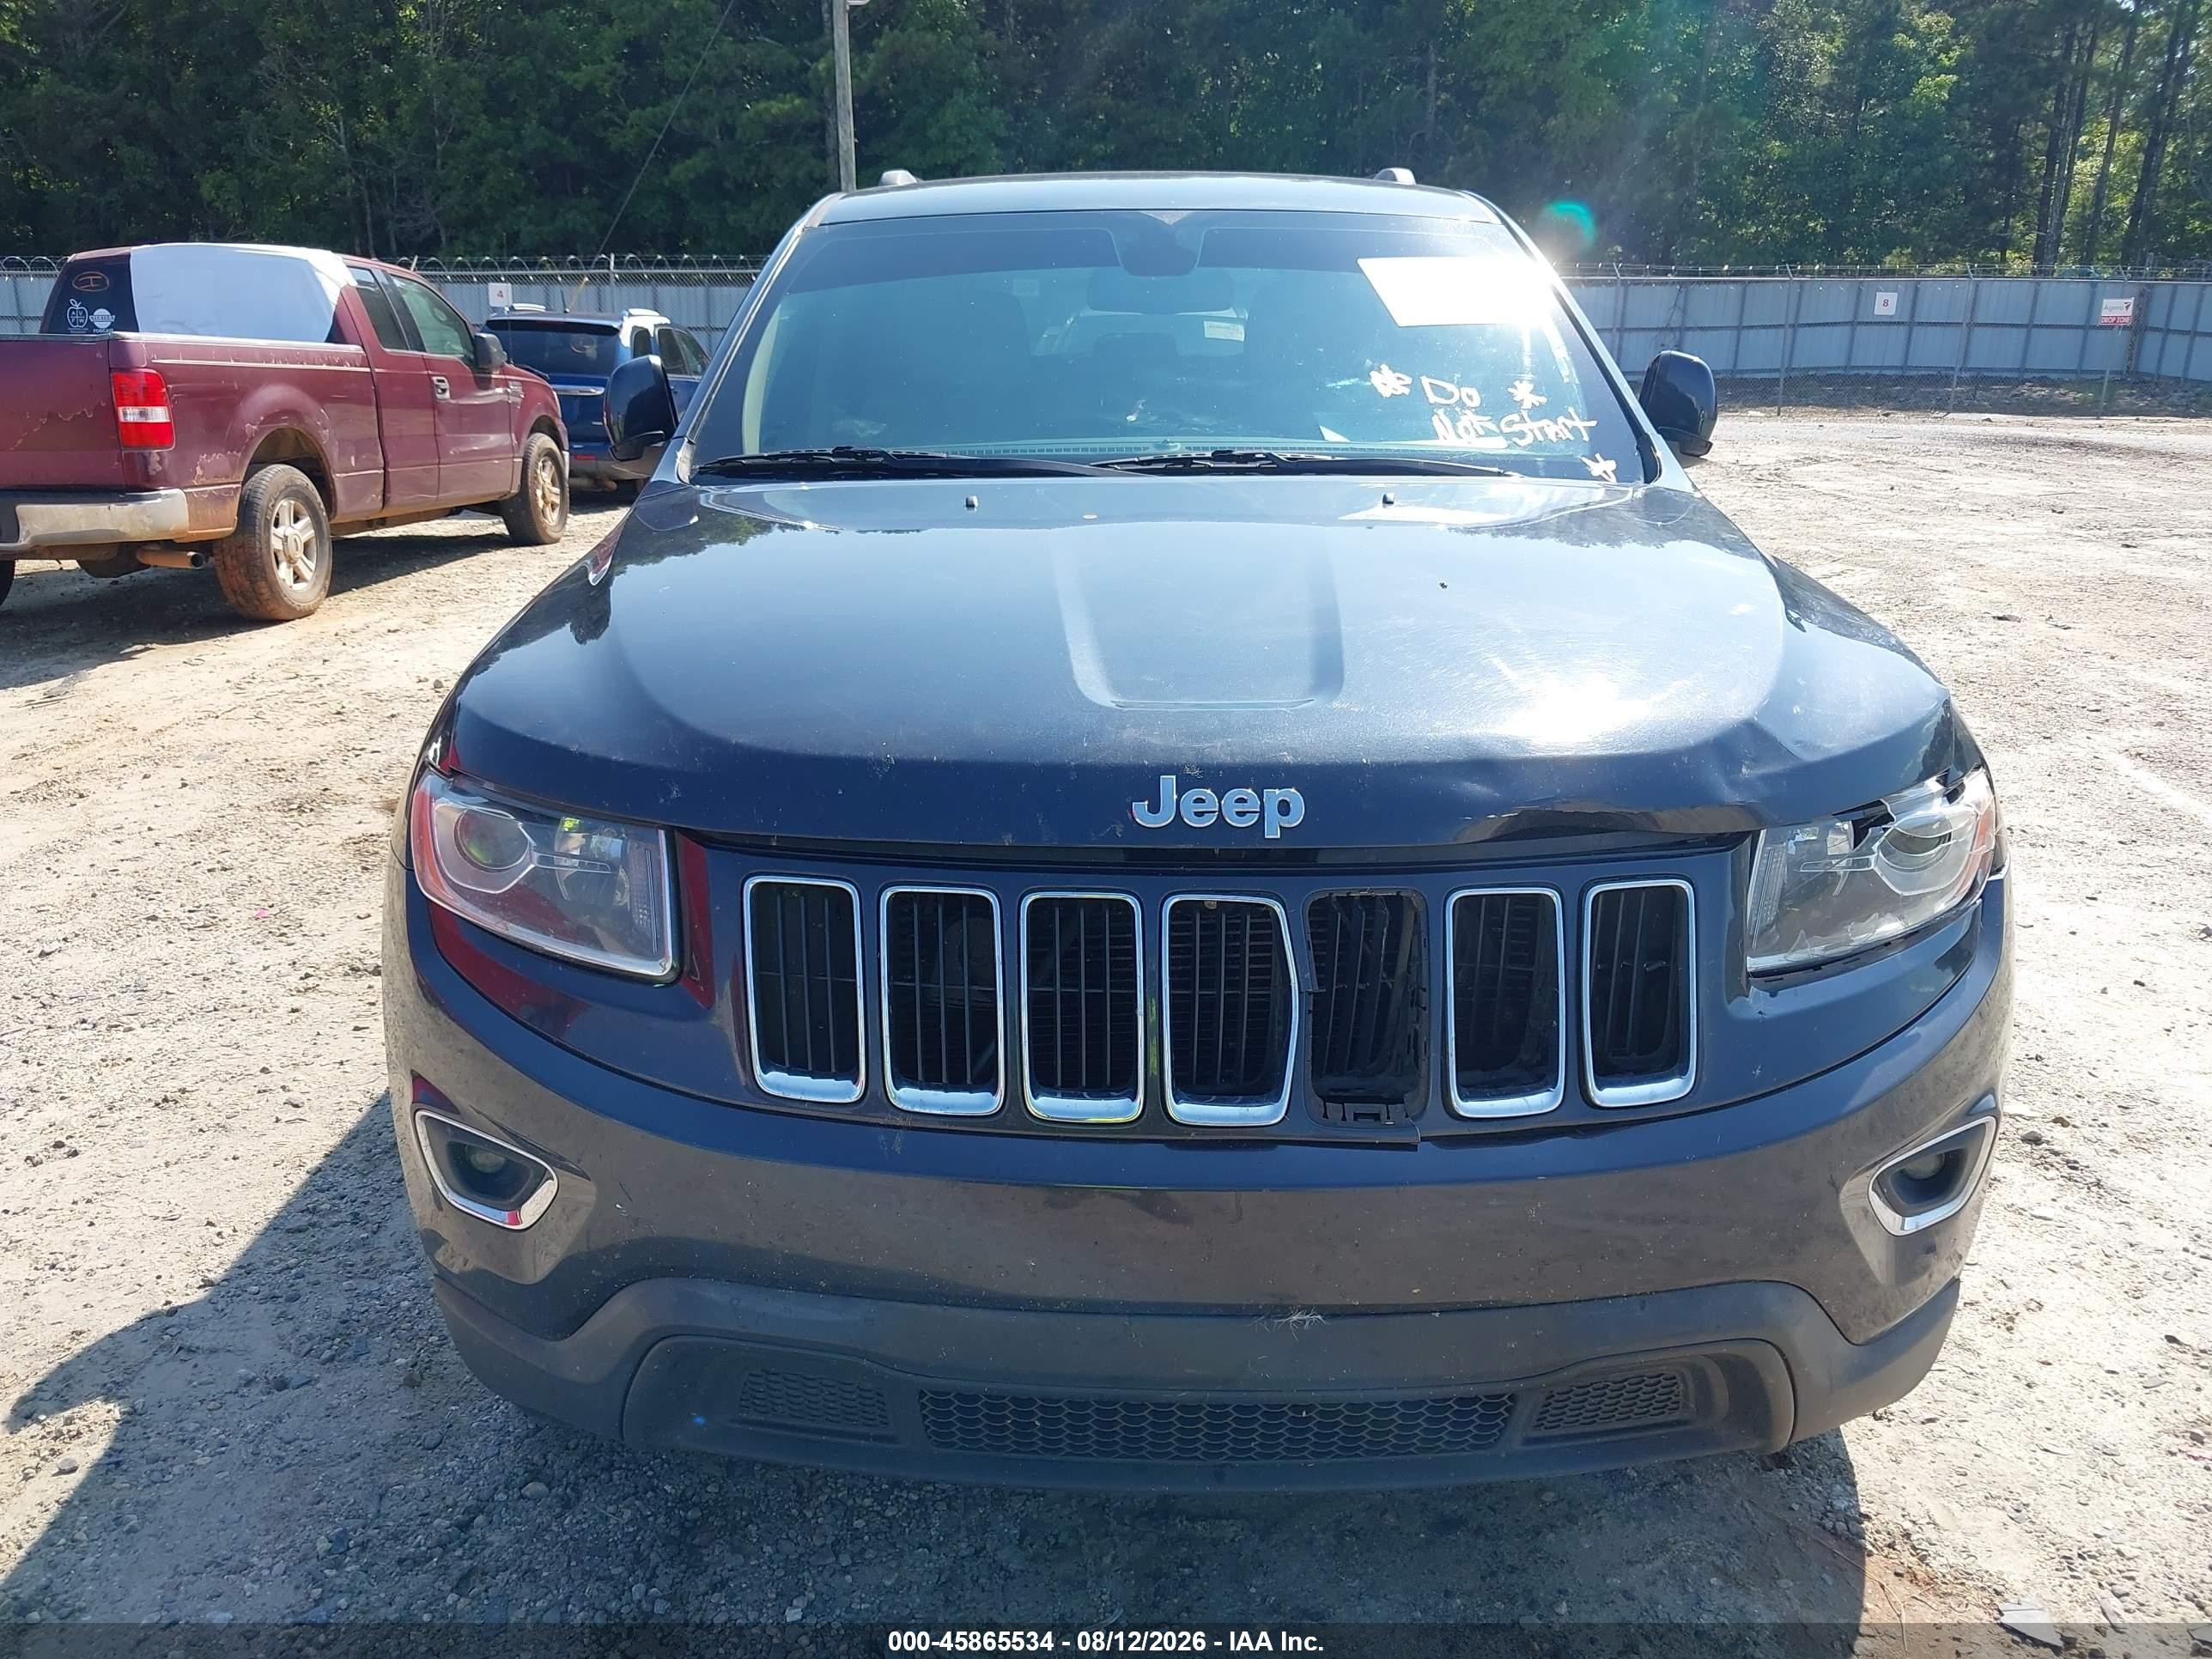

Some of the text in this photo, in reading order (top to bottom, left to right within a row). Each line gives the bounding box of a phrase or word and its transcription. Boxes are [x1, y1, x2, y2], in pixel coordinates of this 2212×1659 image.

[496, 290, 504, 299] 4
[1882, 299, 1889, 307] 8
[1420, 375, 1481, 408] Do
[1500, 407, 1597, 447] Start
[1132, 775, 1305, 839] Jeep
